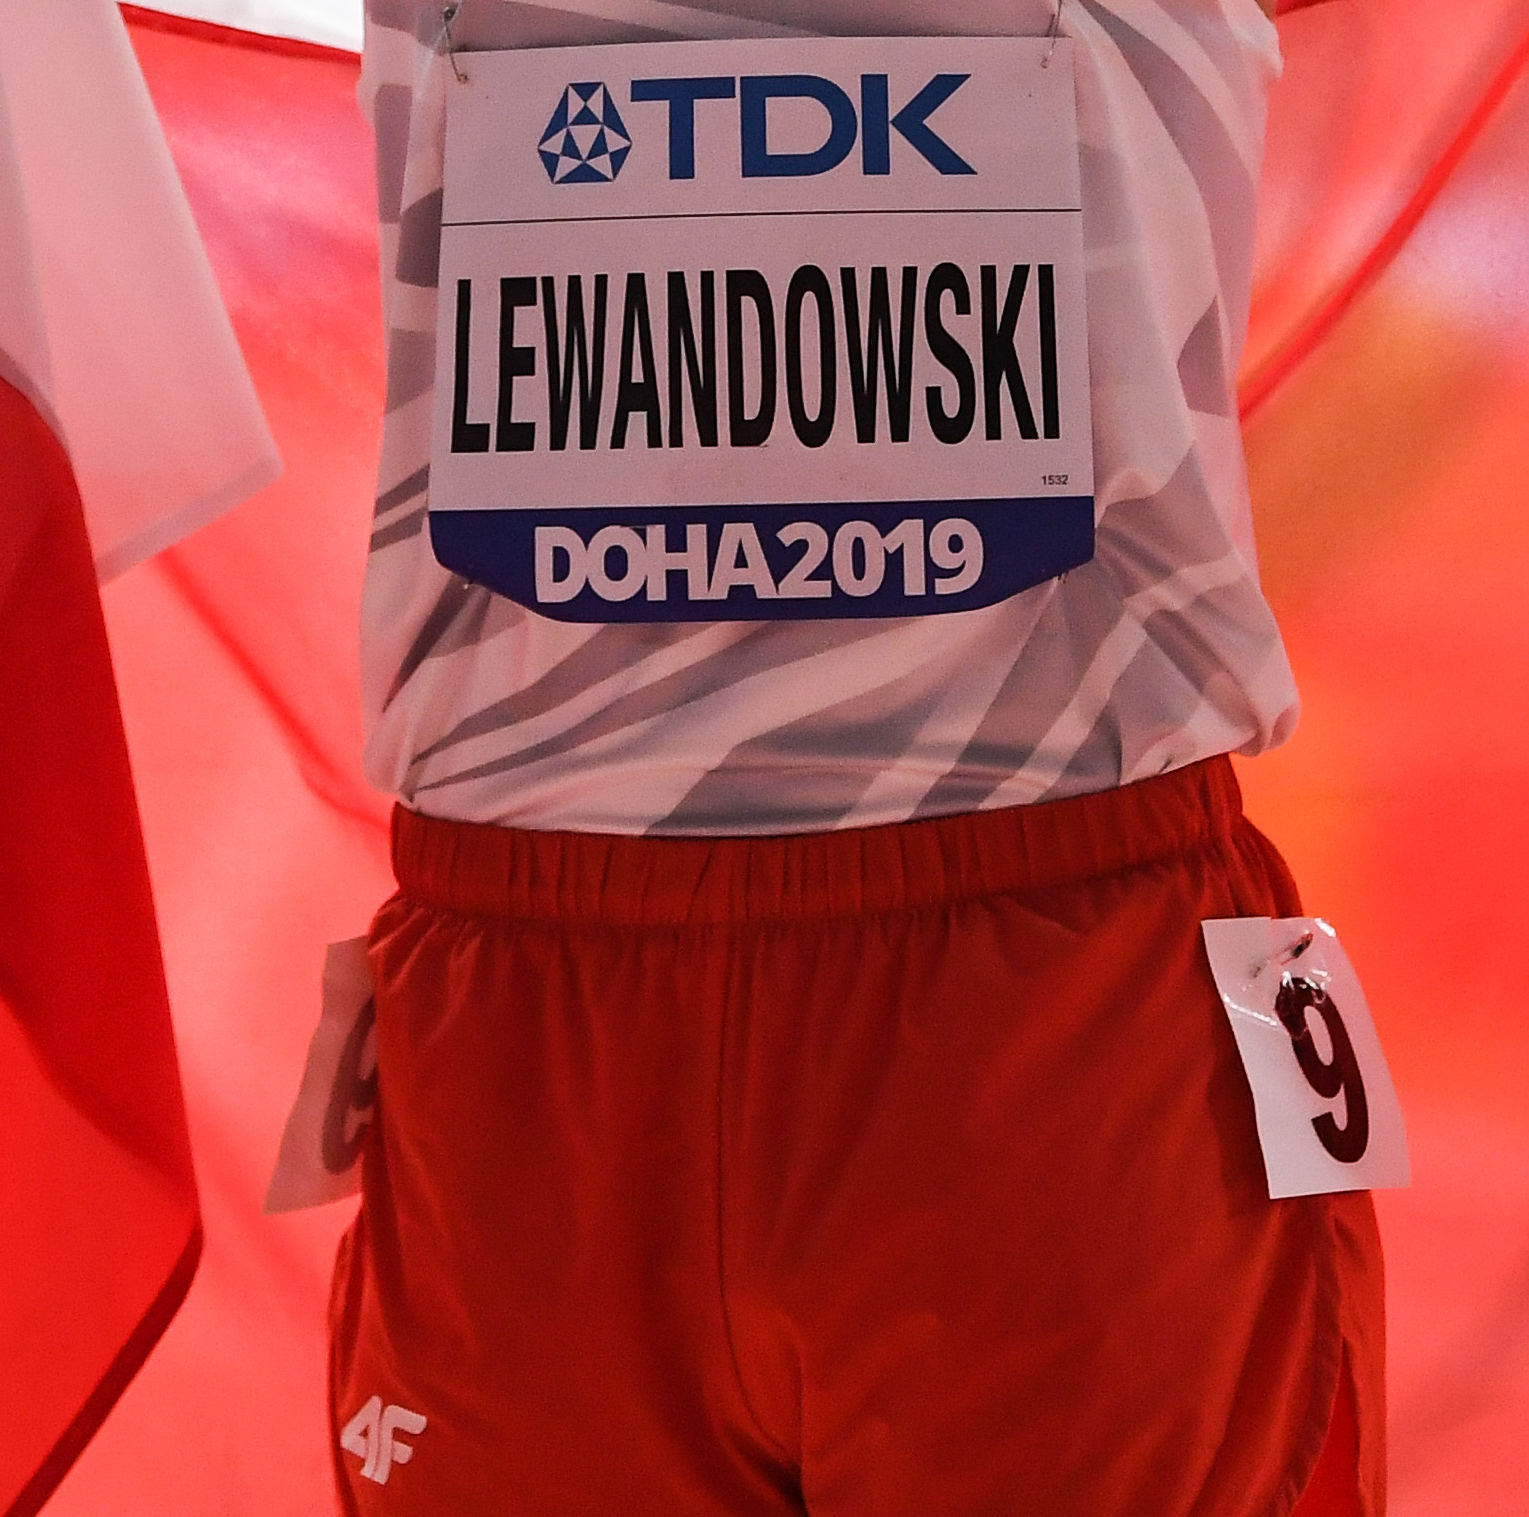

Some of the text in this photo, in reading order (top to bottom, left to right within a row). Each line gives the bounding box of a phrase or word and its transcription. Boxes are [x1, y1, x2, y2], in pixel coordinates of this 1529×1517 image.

[630, 73, 978, 180] TDK
[450, 262, 1062, 454] LEWANDOWSKI
[1041, 474, 1069, 486] 1532
[1274, 976, 1370, 1164] 9
